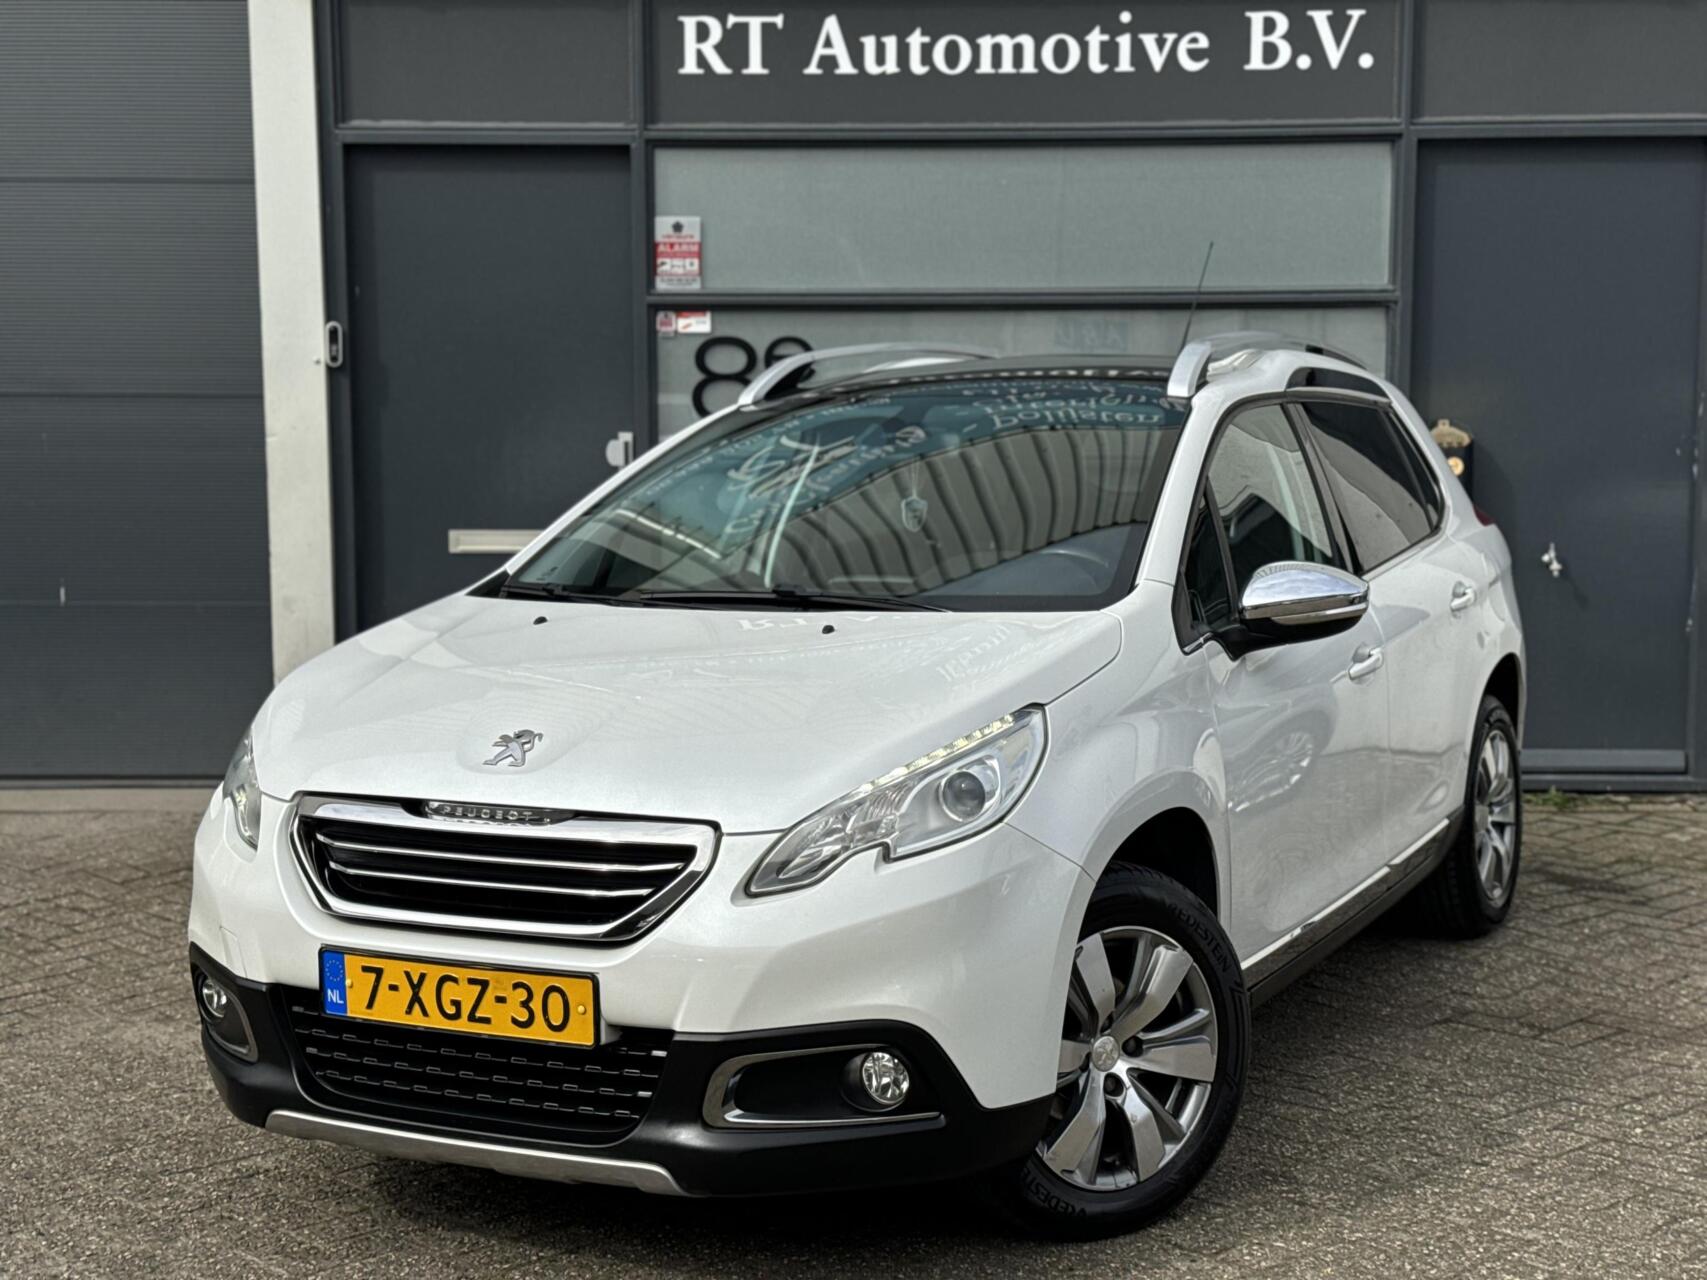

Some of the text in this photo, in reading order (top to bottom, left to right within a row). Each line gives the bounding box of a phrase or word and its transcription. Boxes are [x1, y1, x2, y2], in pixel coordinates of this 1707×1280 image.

[677, 9, 1374, 75] RT Automotive B.V.
[441, 805, 533, 821] PEUGEOT
[327, 989, 344, 1005] NL
[361, 965, 570, 1033] 7-XGZ-30
